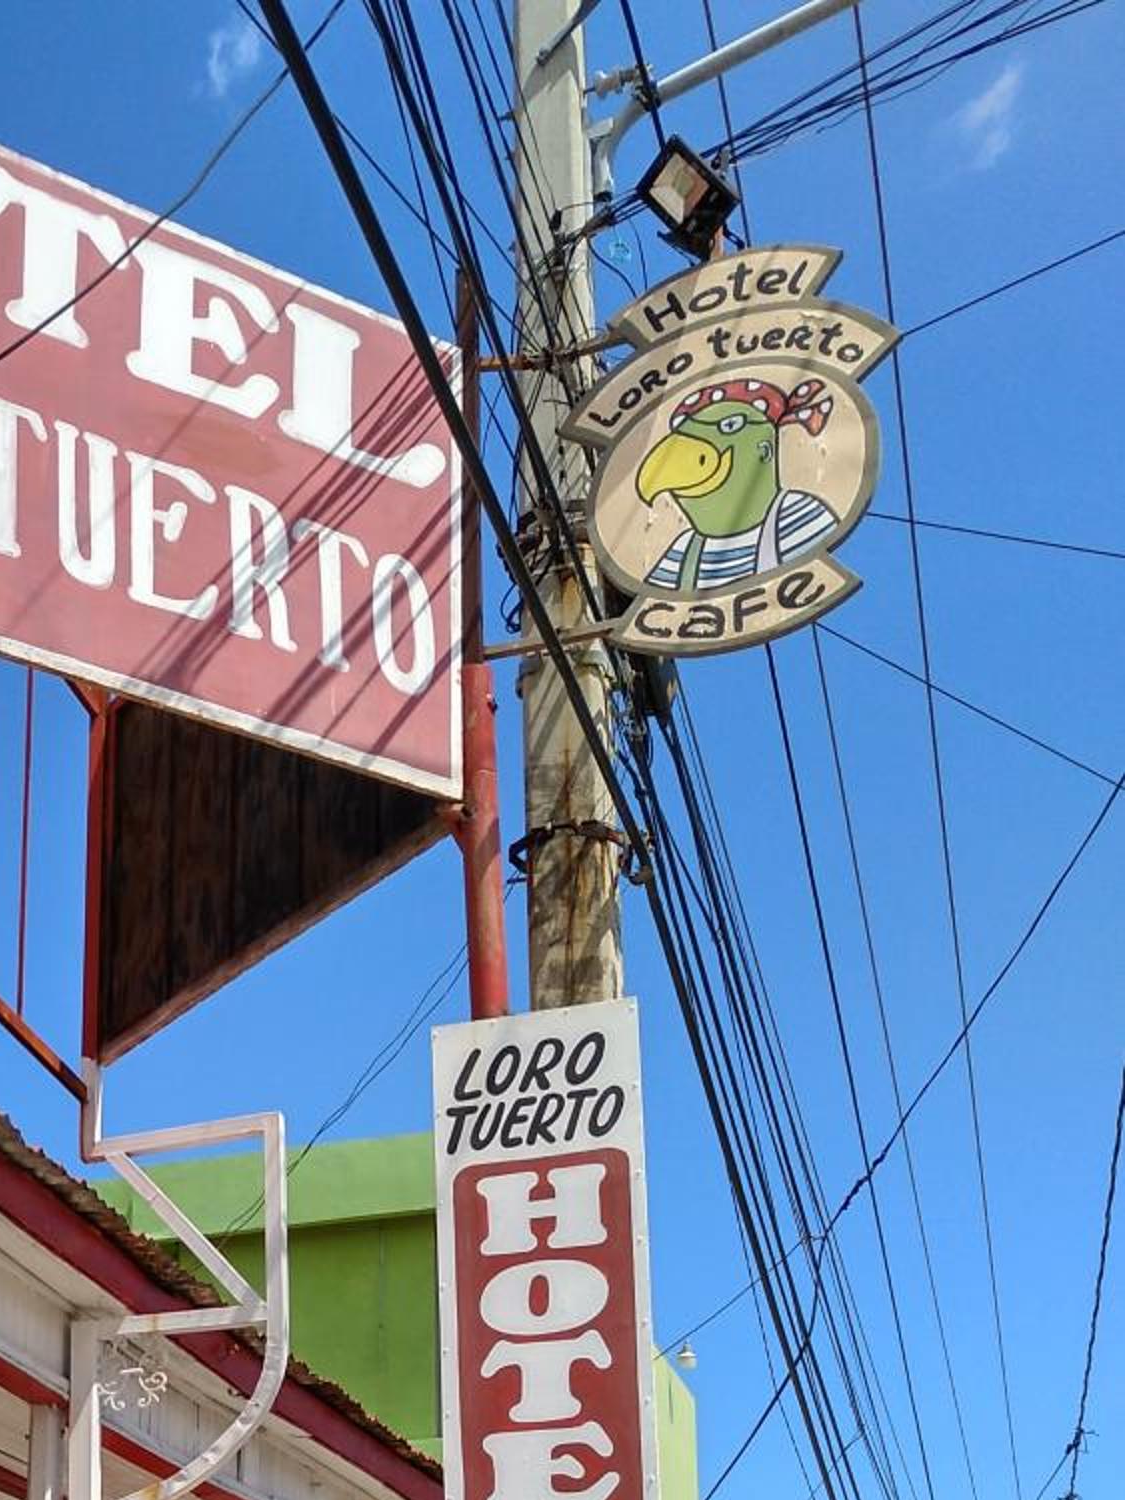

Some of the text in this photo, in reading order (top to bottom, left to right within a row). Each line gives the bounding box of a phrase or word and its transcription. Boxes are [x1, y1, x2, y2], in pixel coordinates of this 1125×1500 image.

[643, 260, 808, 334] Hotel
[454, 1031, 606, 1102] LORO
[446, 1085, 624, 1155] TUERTO
